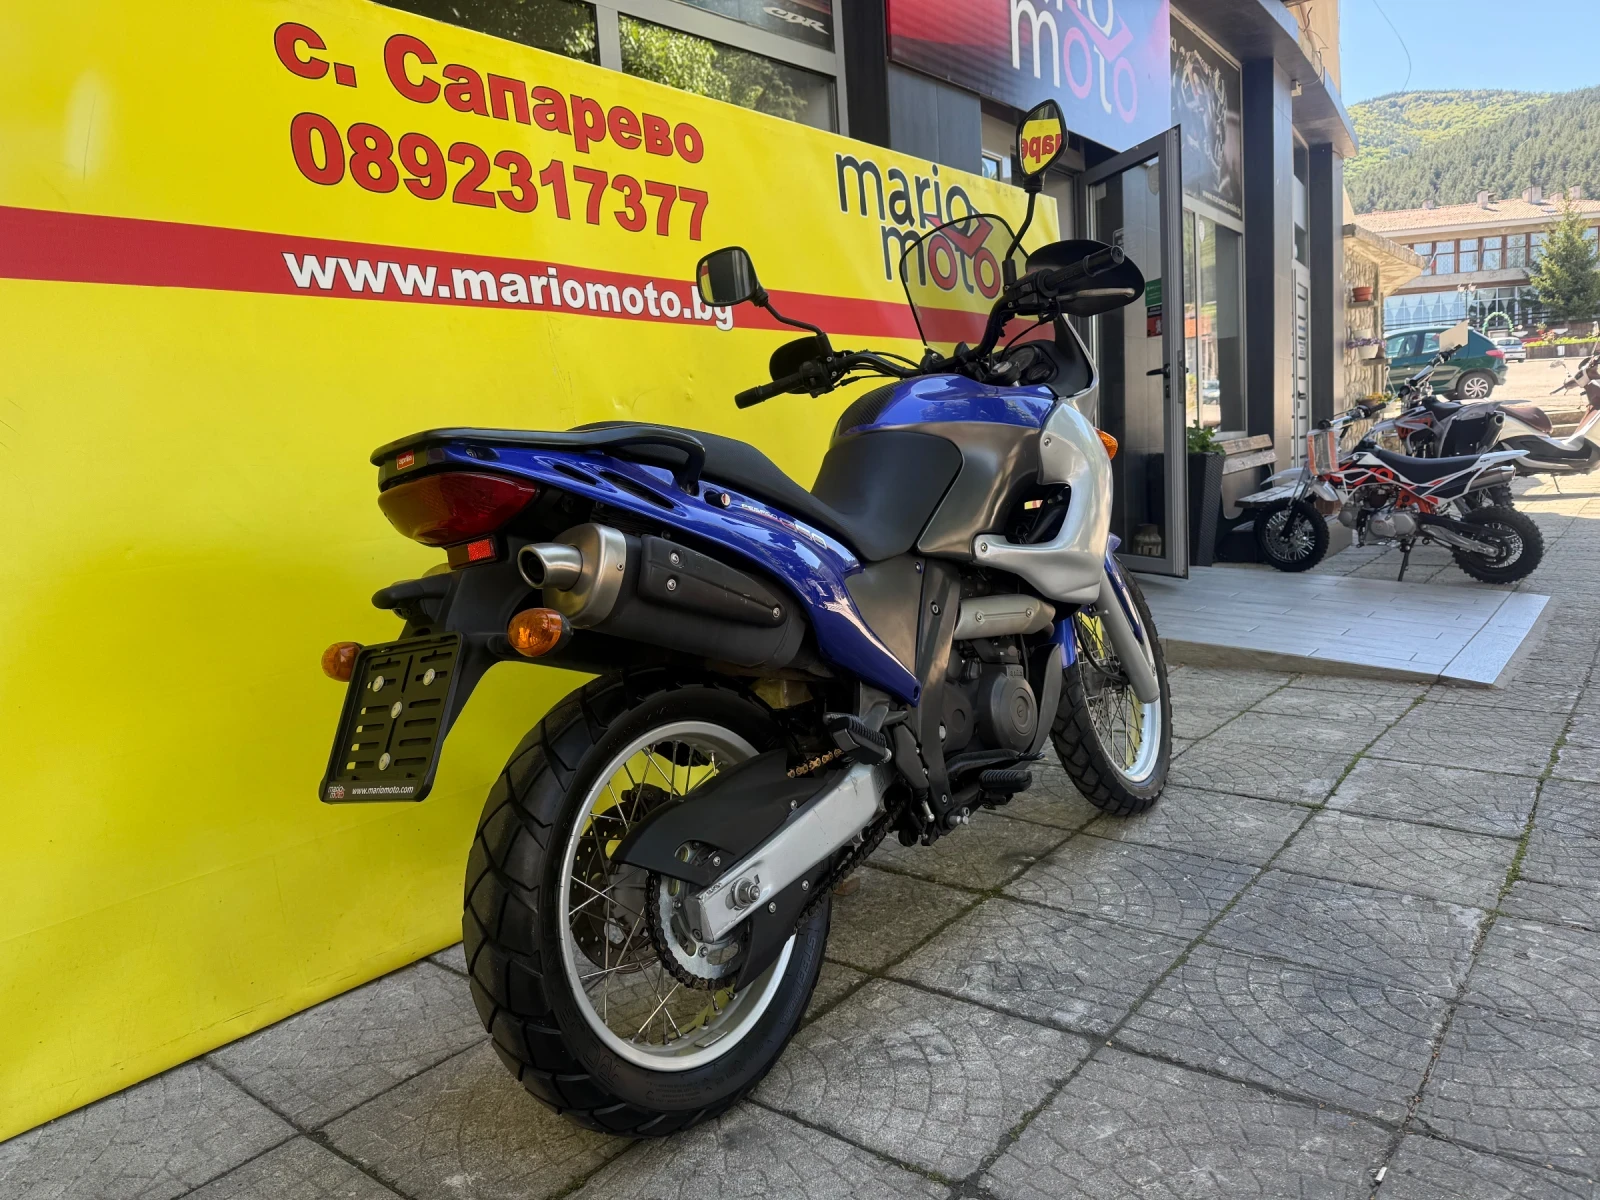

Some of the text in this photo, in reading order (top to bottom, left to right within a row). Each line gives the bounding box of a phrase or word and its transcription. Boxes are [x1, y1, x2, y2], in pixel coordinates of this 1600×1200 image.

[763, 7, 830, 35] CBR
[1010, 0, 1138, 124] moto
[273, 21, 704, 164] с. Сапарево
[290, 112, 709, 241] 0892317377
[835, 153, 973, 237] mario
[281, 251, 734, 331] www.mariomoto.bg
[881, 225, 1001, 299] moto
[351, 785, 414, 795] www.mariomoto.com
